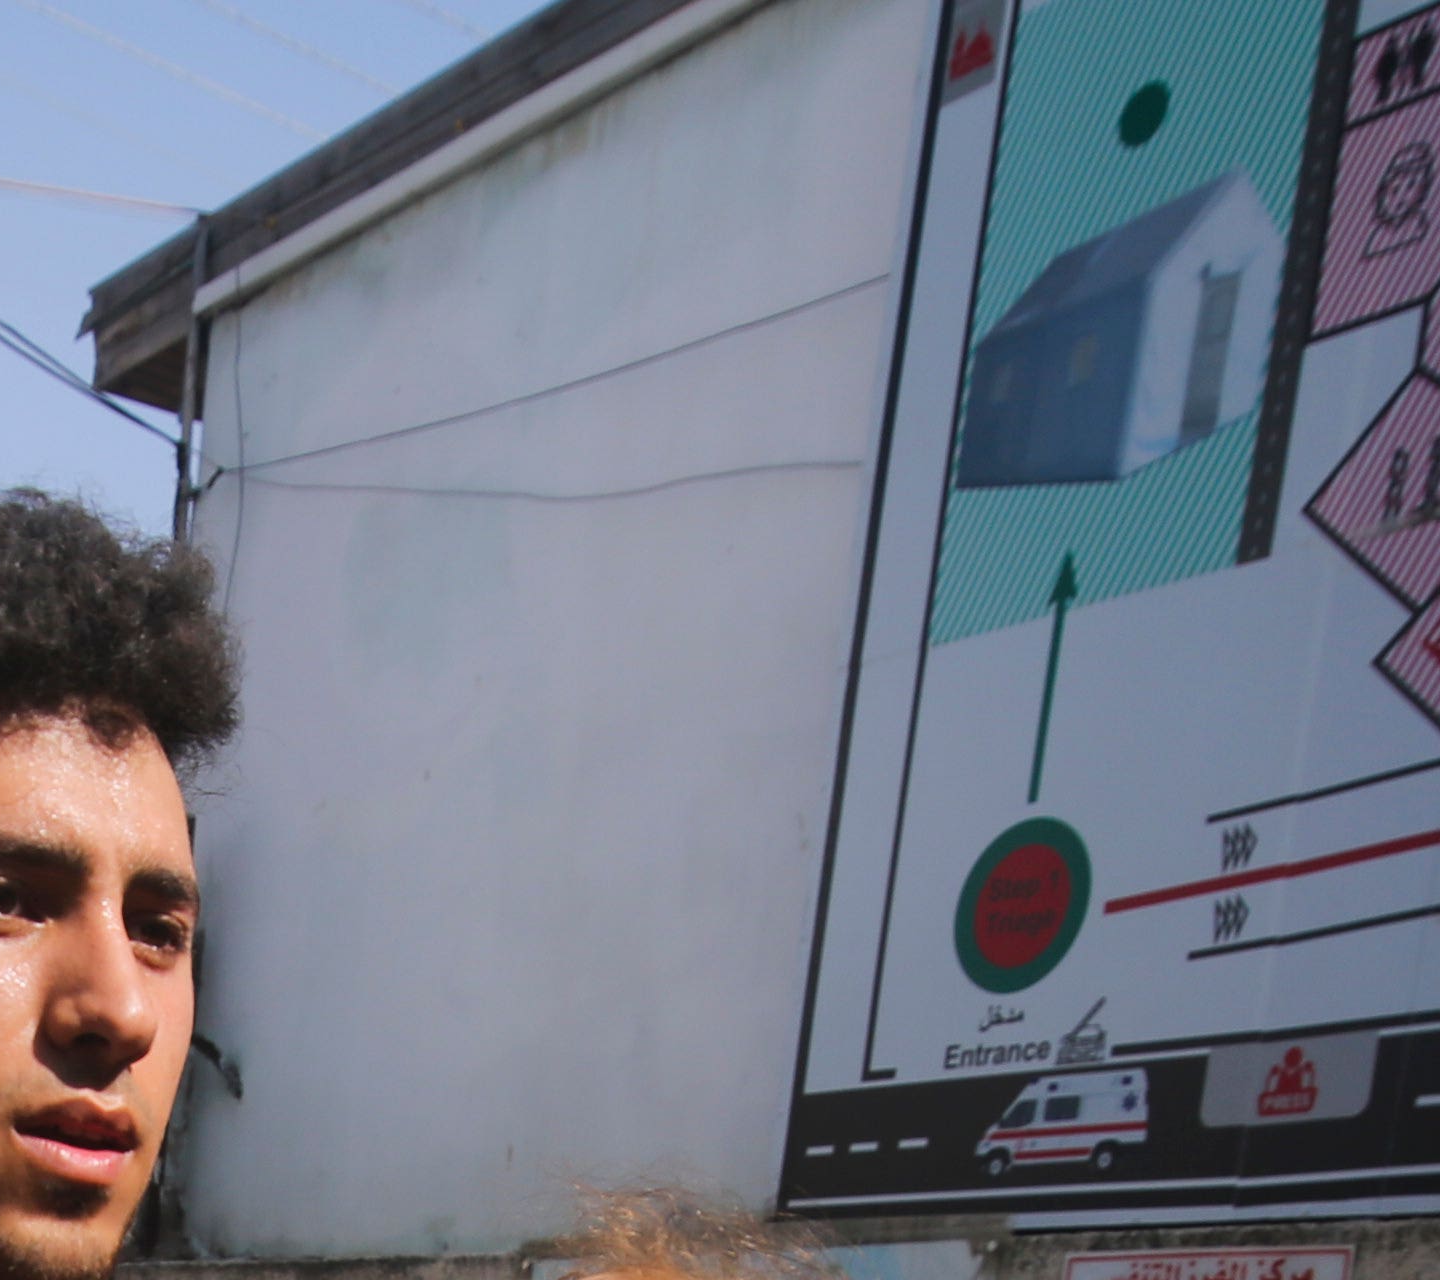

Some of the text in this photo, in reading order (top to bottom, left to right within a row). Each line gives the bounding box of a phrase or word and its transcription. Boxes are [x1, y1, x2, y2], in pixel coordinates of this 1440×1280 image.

[989, 868, 1061, 902] Step 1
[986, 907, 1058, 937] Triage
[943, 1039, 1052, 1071] Entrance
